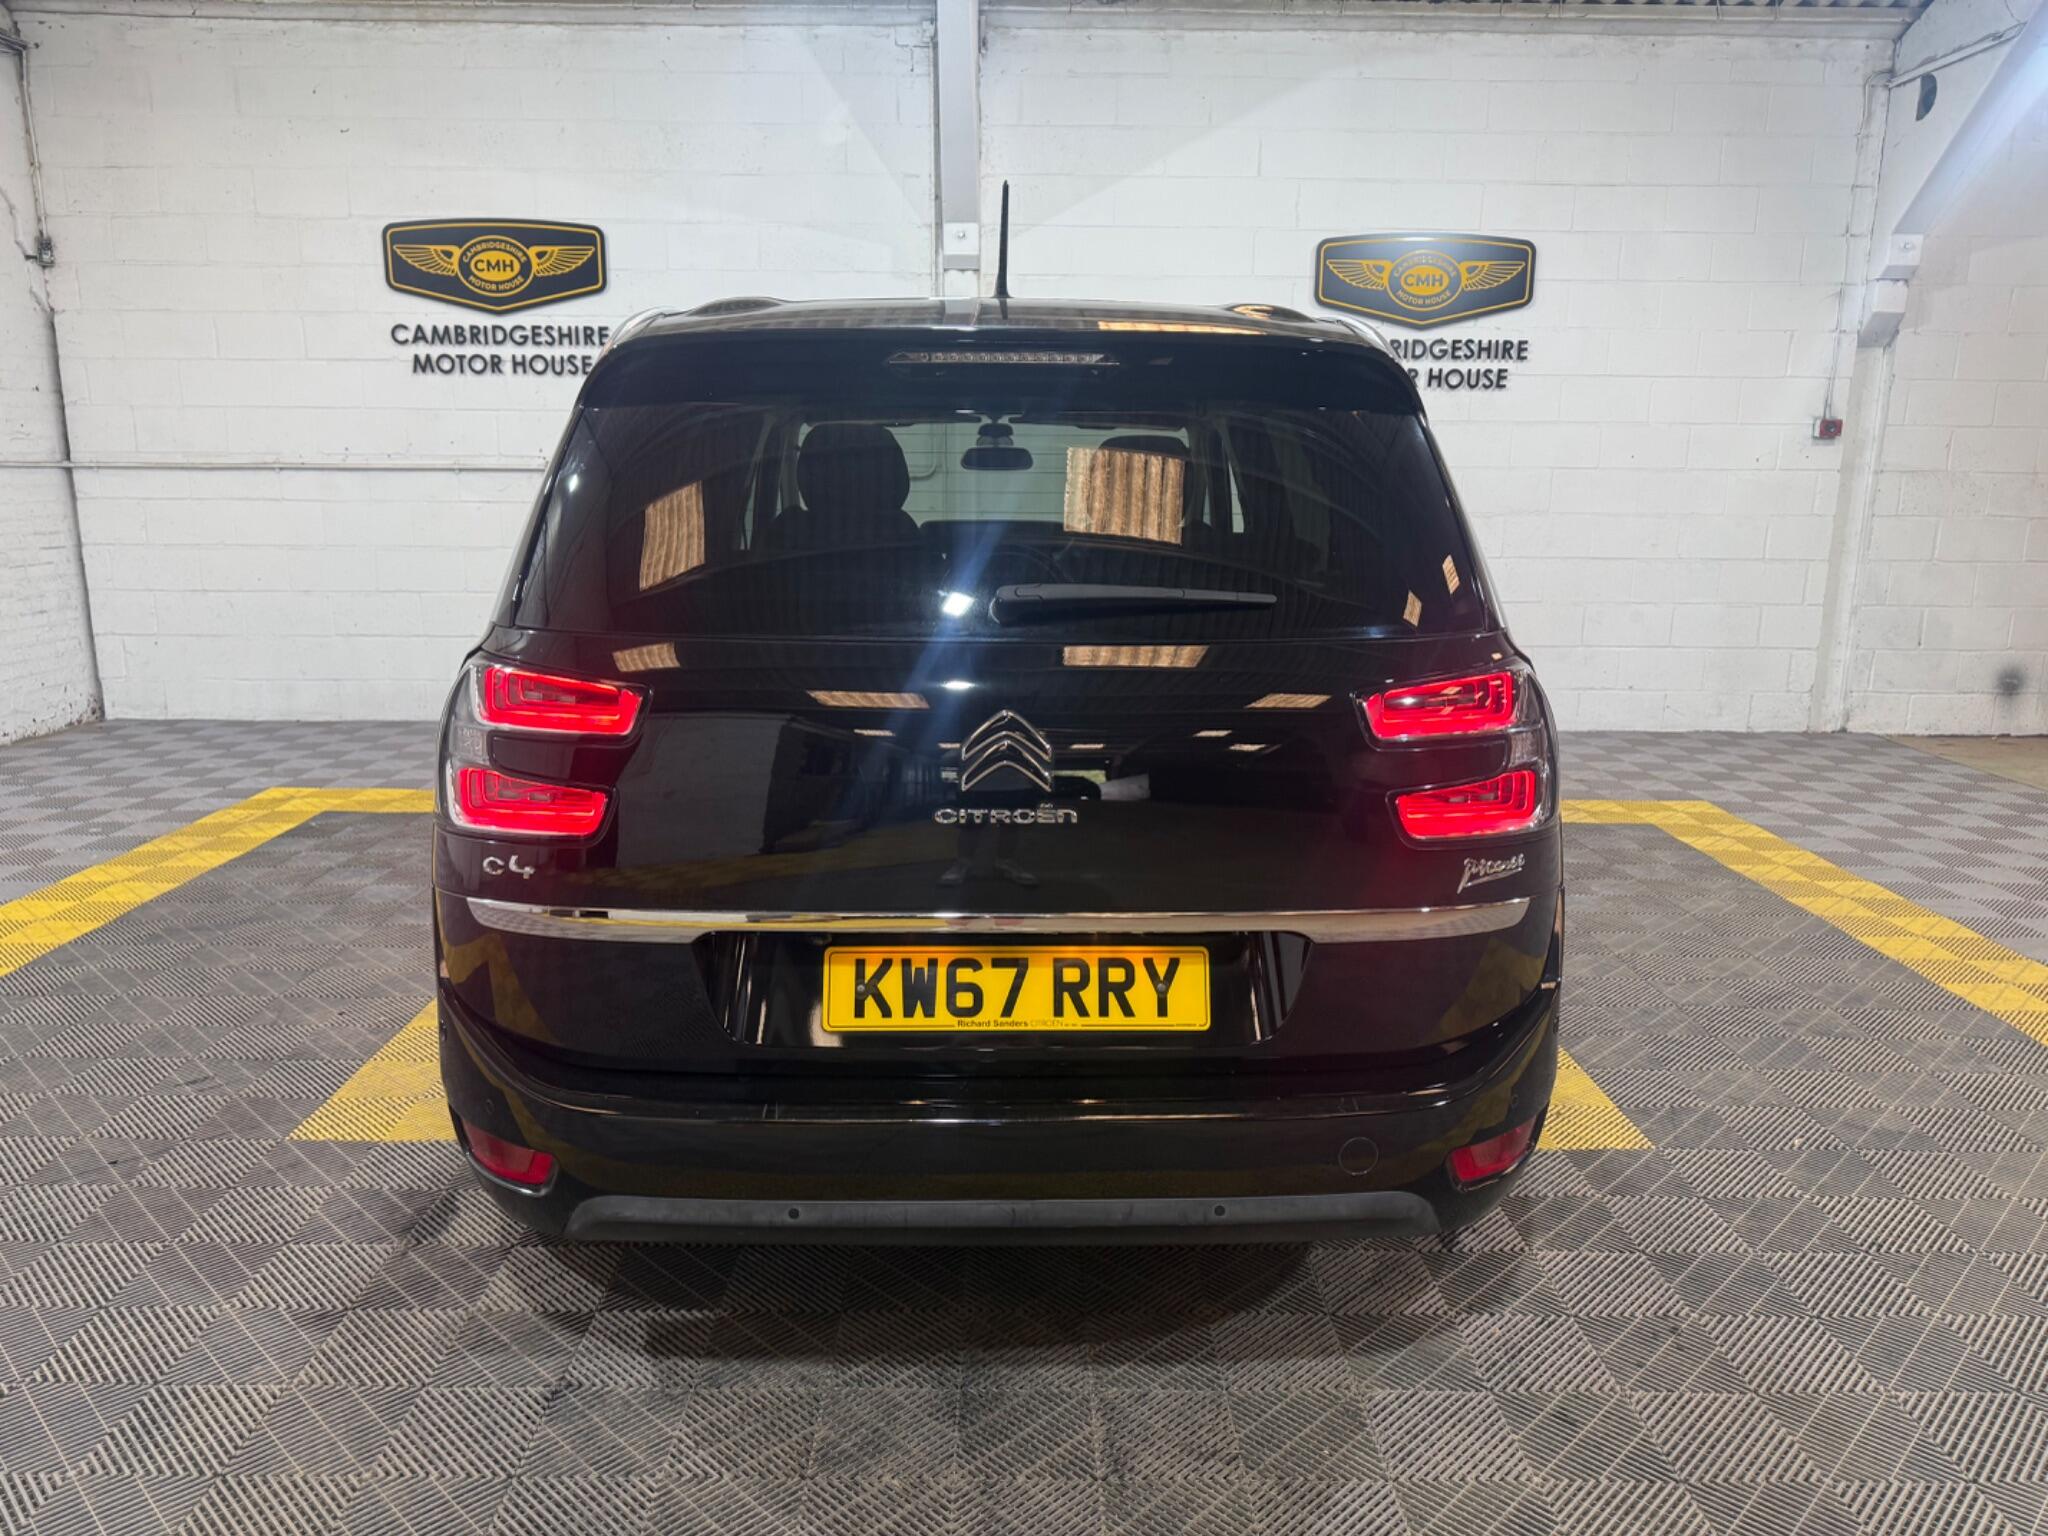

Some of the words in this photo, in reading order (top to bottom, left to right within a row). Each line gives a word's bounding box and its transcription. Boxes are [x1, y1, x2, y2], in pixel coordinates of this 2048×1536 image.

[474, 259, 515, 272] CMH
[468, 275, 497, 290] MOTOR
[1404, 273, 1444, 288] CMH
[391, 324, 609, 346] CAMBRIDGESHIRE
[1389, 339, 1529, 361] RIDGESHIRE
[413, 354, 504, 375] MOTOR
[512, 354, 593, 376] HOUSE
[1427, 367, 1508, 389] HOUSE
[483, 855, 535, 880] C4
[853, 957, 1030, 1019] KW67
[1053, 957, 1181, 1019] RRY
[957, 1019, 992, 1028] Richard
[993, 1019, 1028, 1028] Sanders
